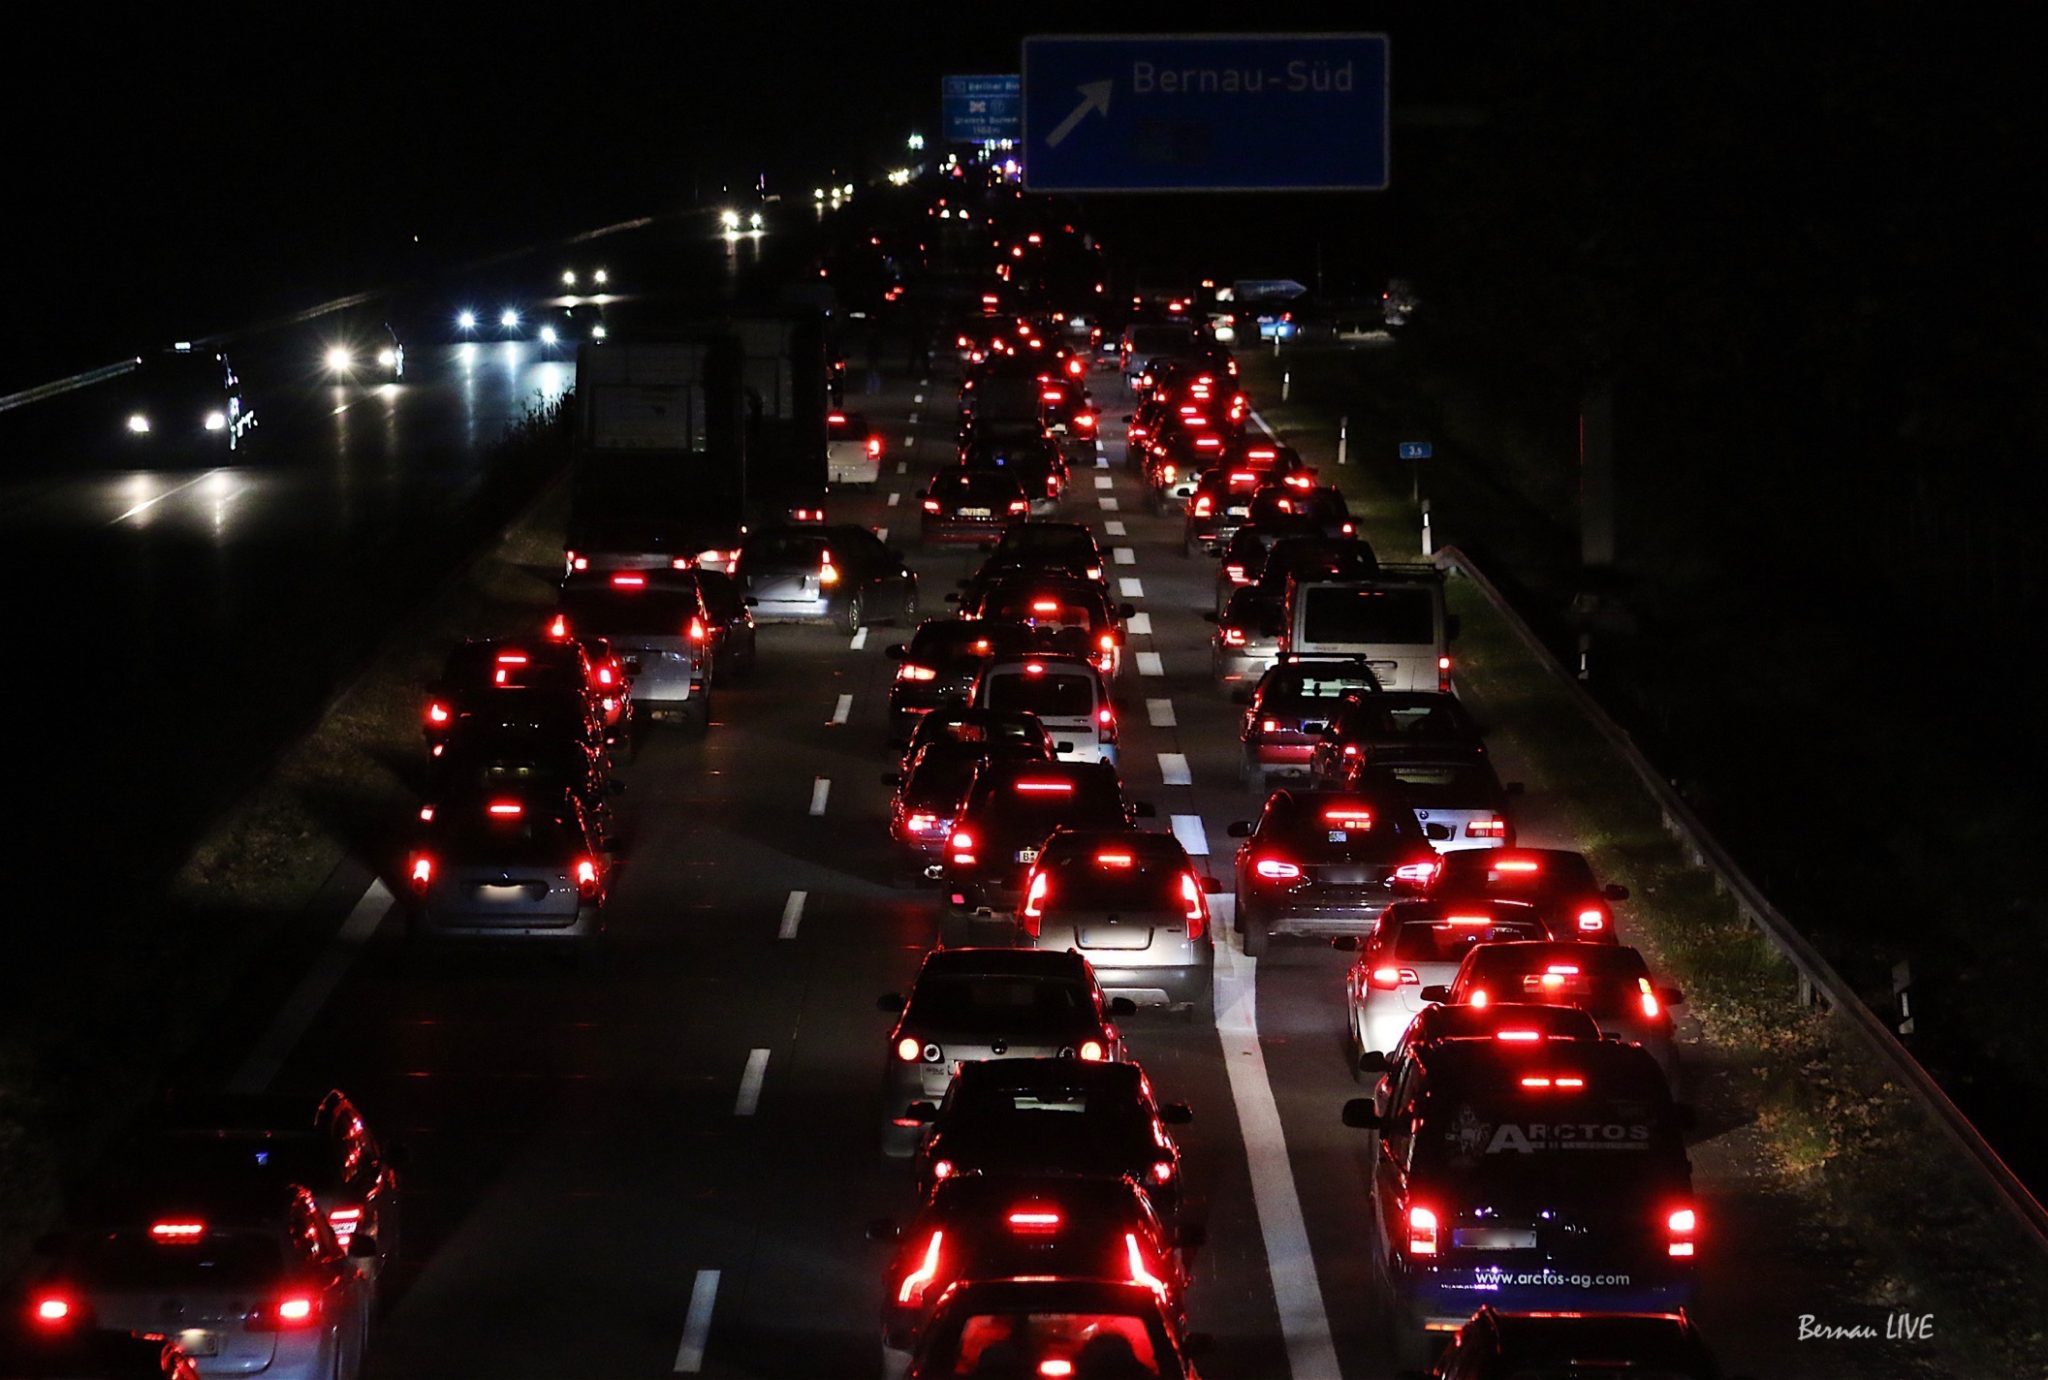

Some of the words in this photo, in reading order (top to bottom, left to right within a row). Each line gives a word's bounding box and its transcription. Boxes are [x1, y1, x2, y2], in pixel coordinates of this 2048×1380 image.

[1132, 59, 1354, 94] Bernau-Süd
[1485, 1123, 1650, 1155] ARCTOS
[1475, 1271, 1631, 1289] www.arctos-ag.com
